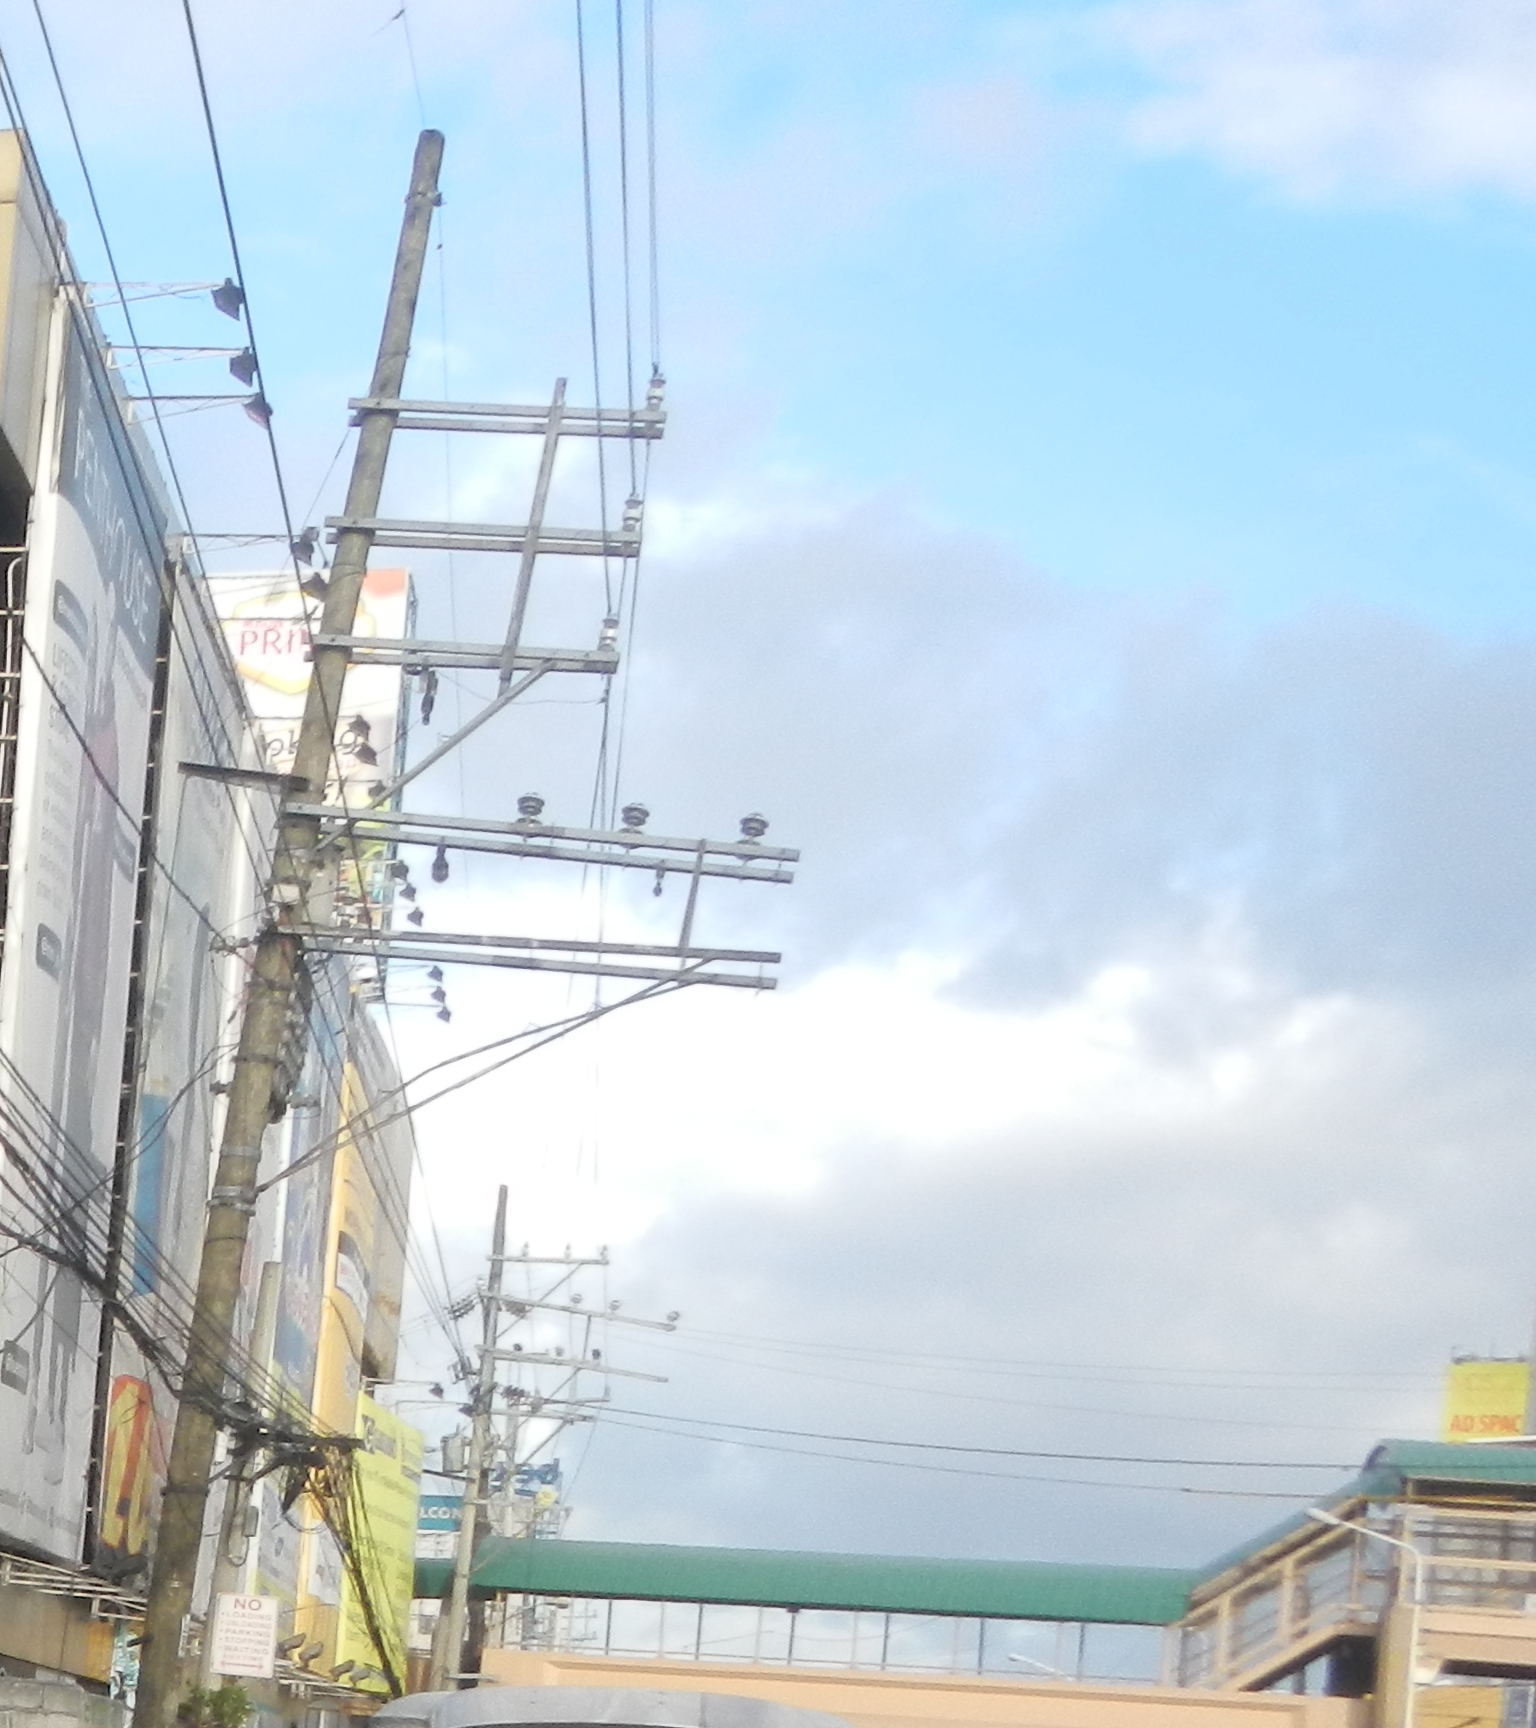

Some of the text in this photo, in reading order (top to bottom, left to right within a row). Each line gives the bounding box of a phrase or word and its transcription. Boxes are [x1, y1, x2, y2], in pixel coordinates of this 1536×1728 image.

[1450, 1414, 1474, 1434] AD
[233, 1598, 262, 1611] NO
[226, 1611, 272, 1621] LOADING
[225, 1628, 270, 1638] PARKING
[224, 1636, 269, 1646] STOPPING
